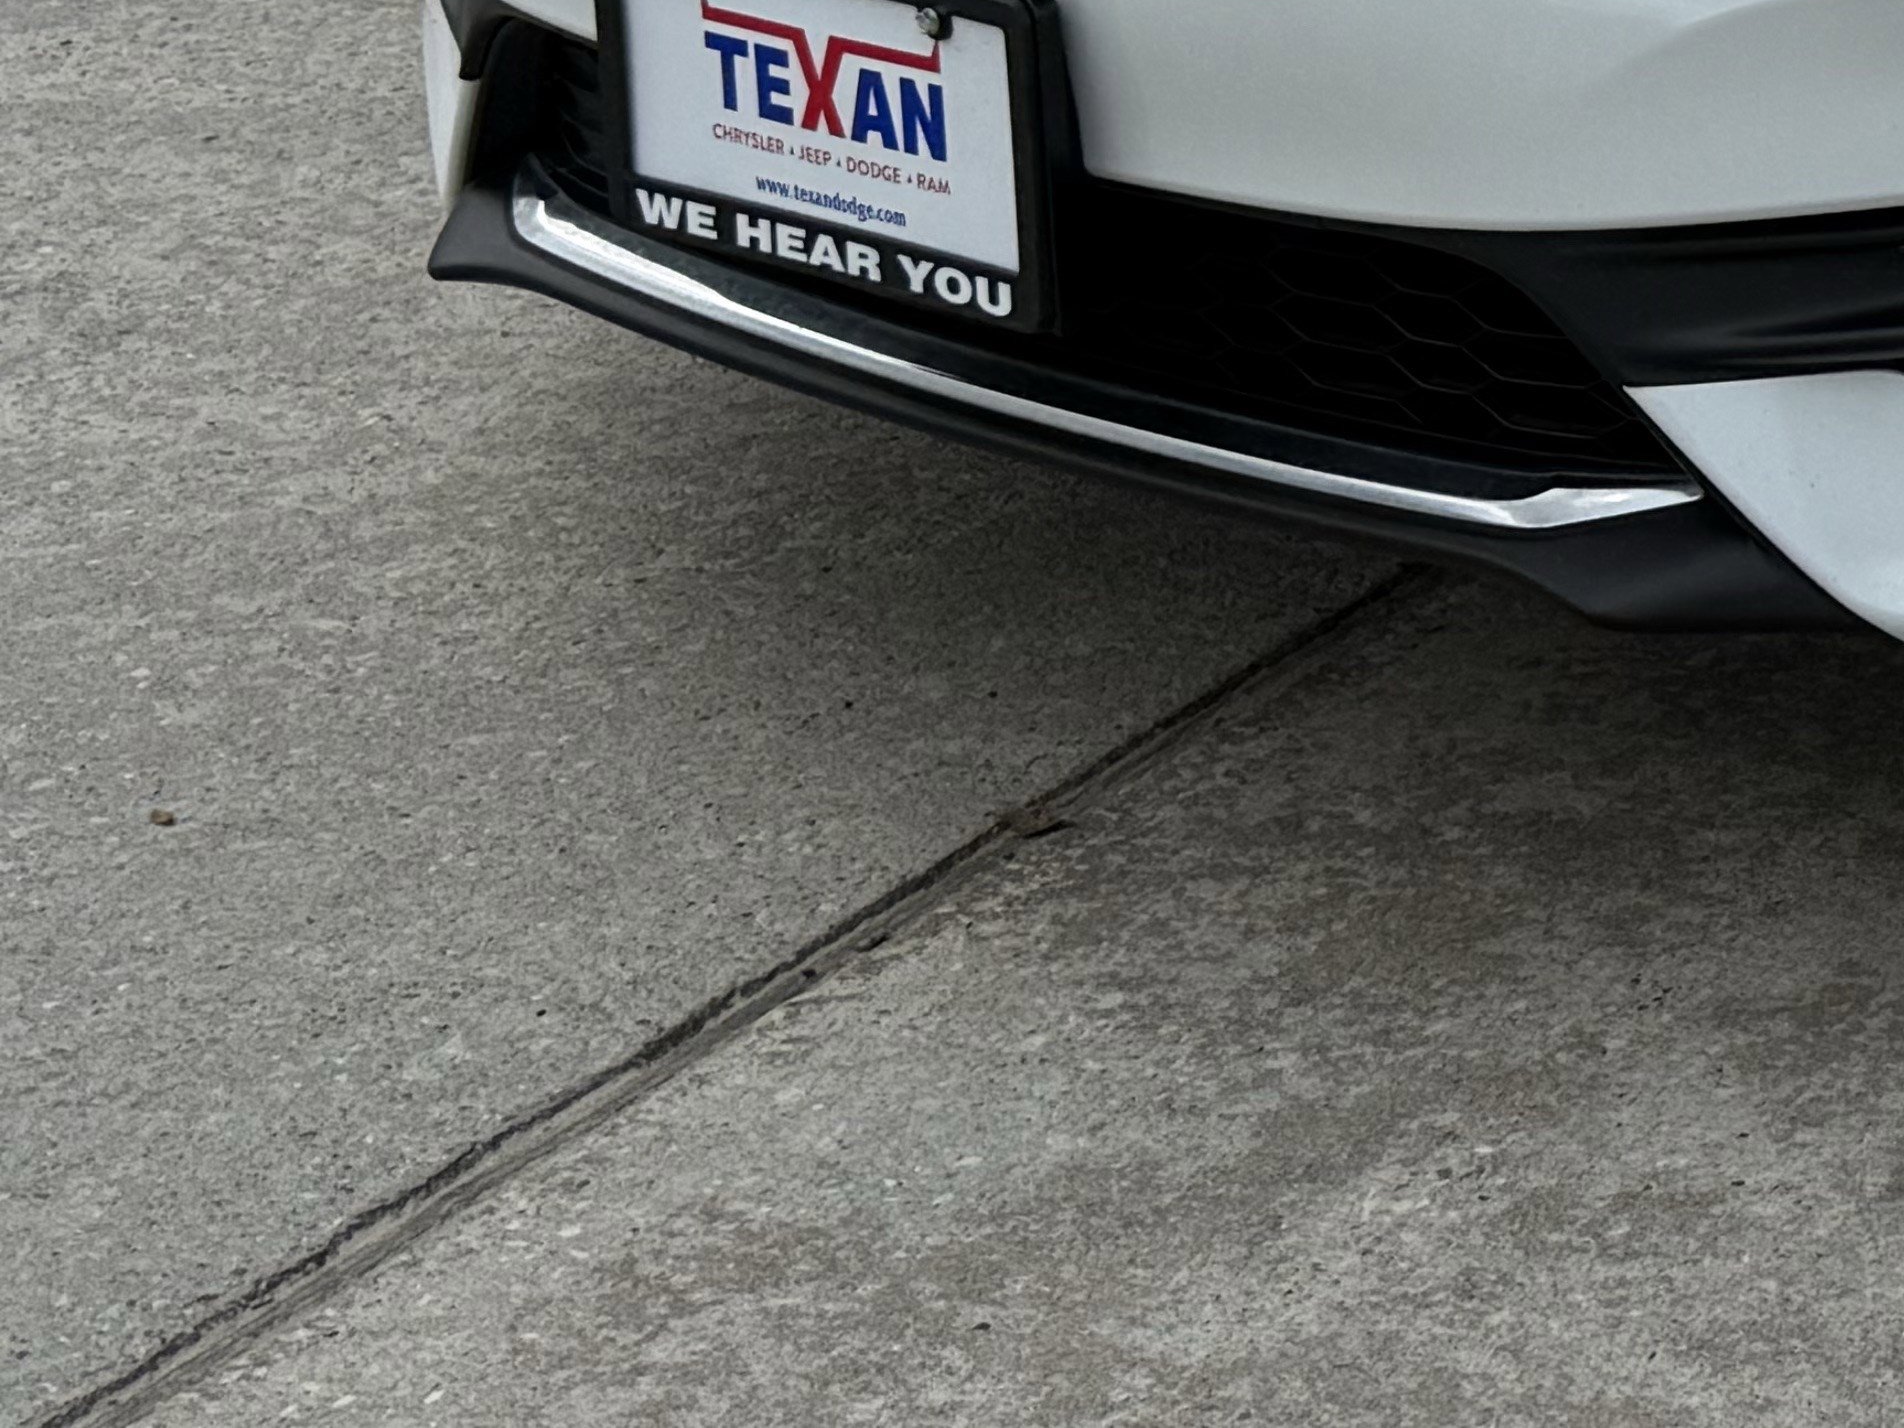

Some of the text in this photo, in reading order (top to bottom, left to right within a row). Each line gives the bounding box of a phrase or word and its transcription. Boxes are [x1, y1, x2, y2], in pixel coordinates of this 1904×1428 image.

[711, 122, 952, 195] CHRYSLER JEEP DODGE RAM
[635, 188, 1013, 317] WE HEAR YOU
